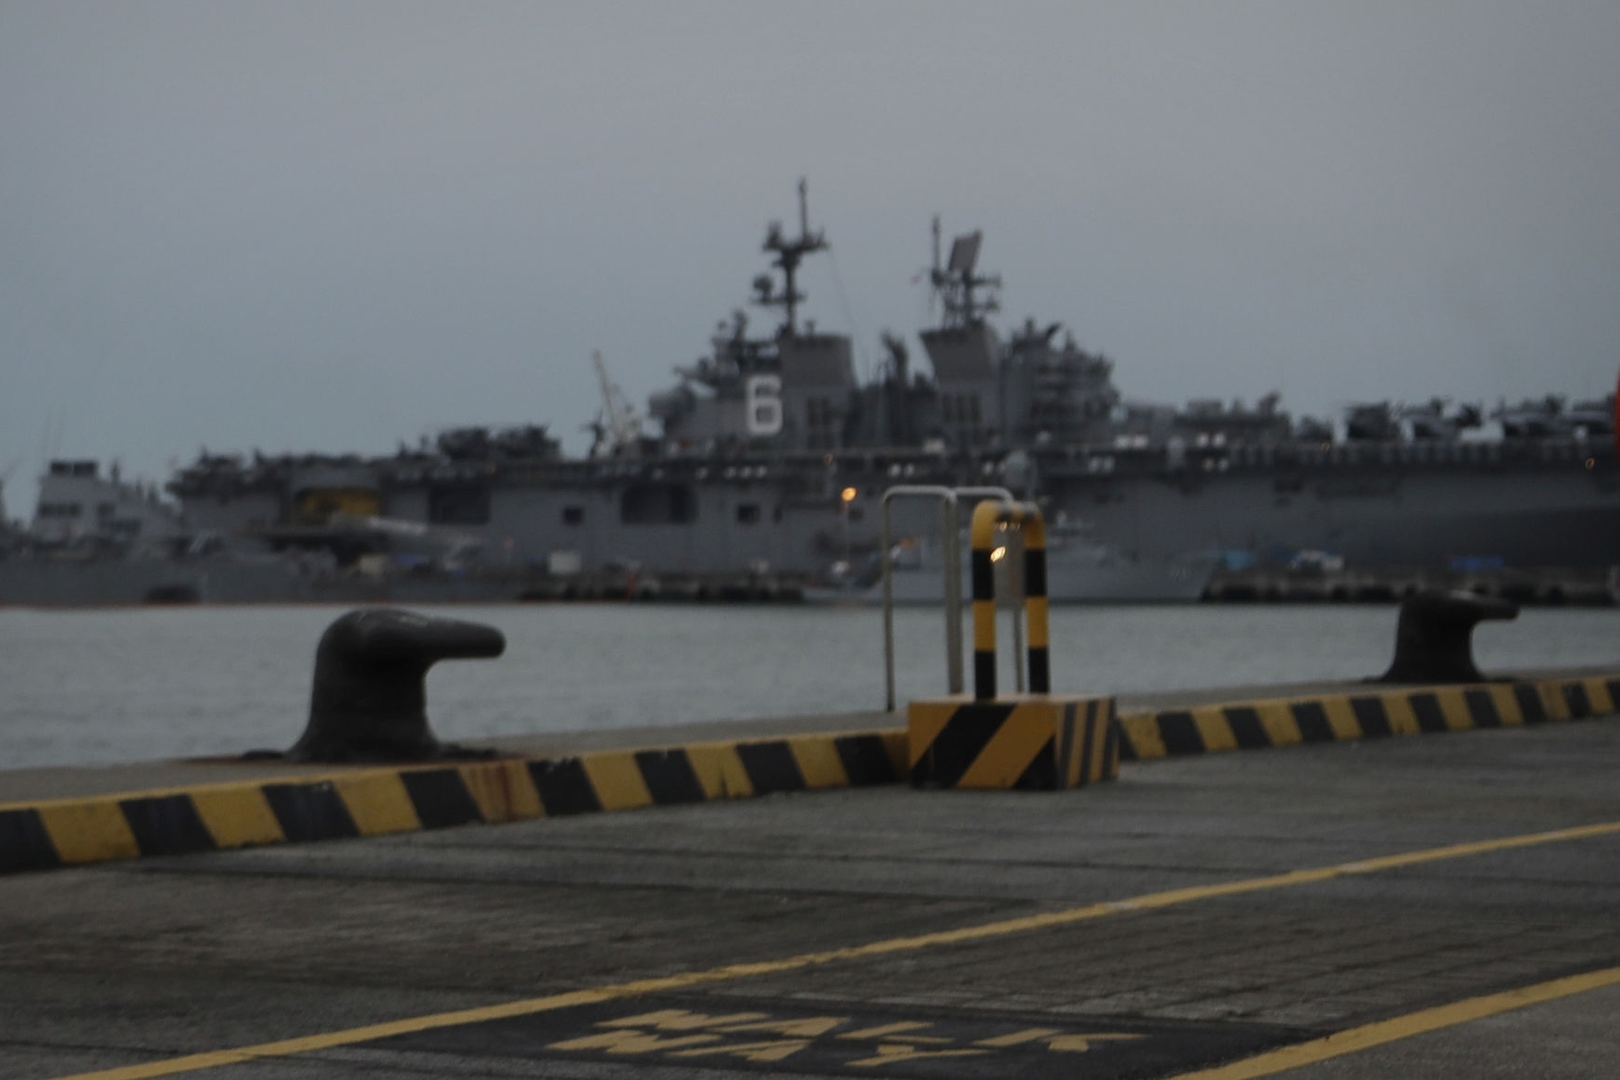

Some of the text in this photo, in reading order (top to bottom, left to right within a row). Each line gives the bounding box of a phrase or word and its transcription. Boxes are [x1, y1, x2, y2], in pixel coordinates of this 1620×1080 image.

[746, 373, 784, 436] 6
[544, 1028, 992, 1068] WAY
[594, 1008, 1152, 1053] WALK
